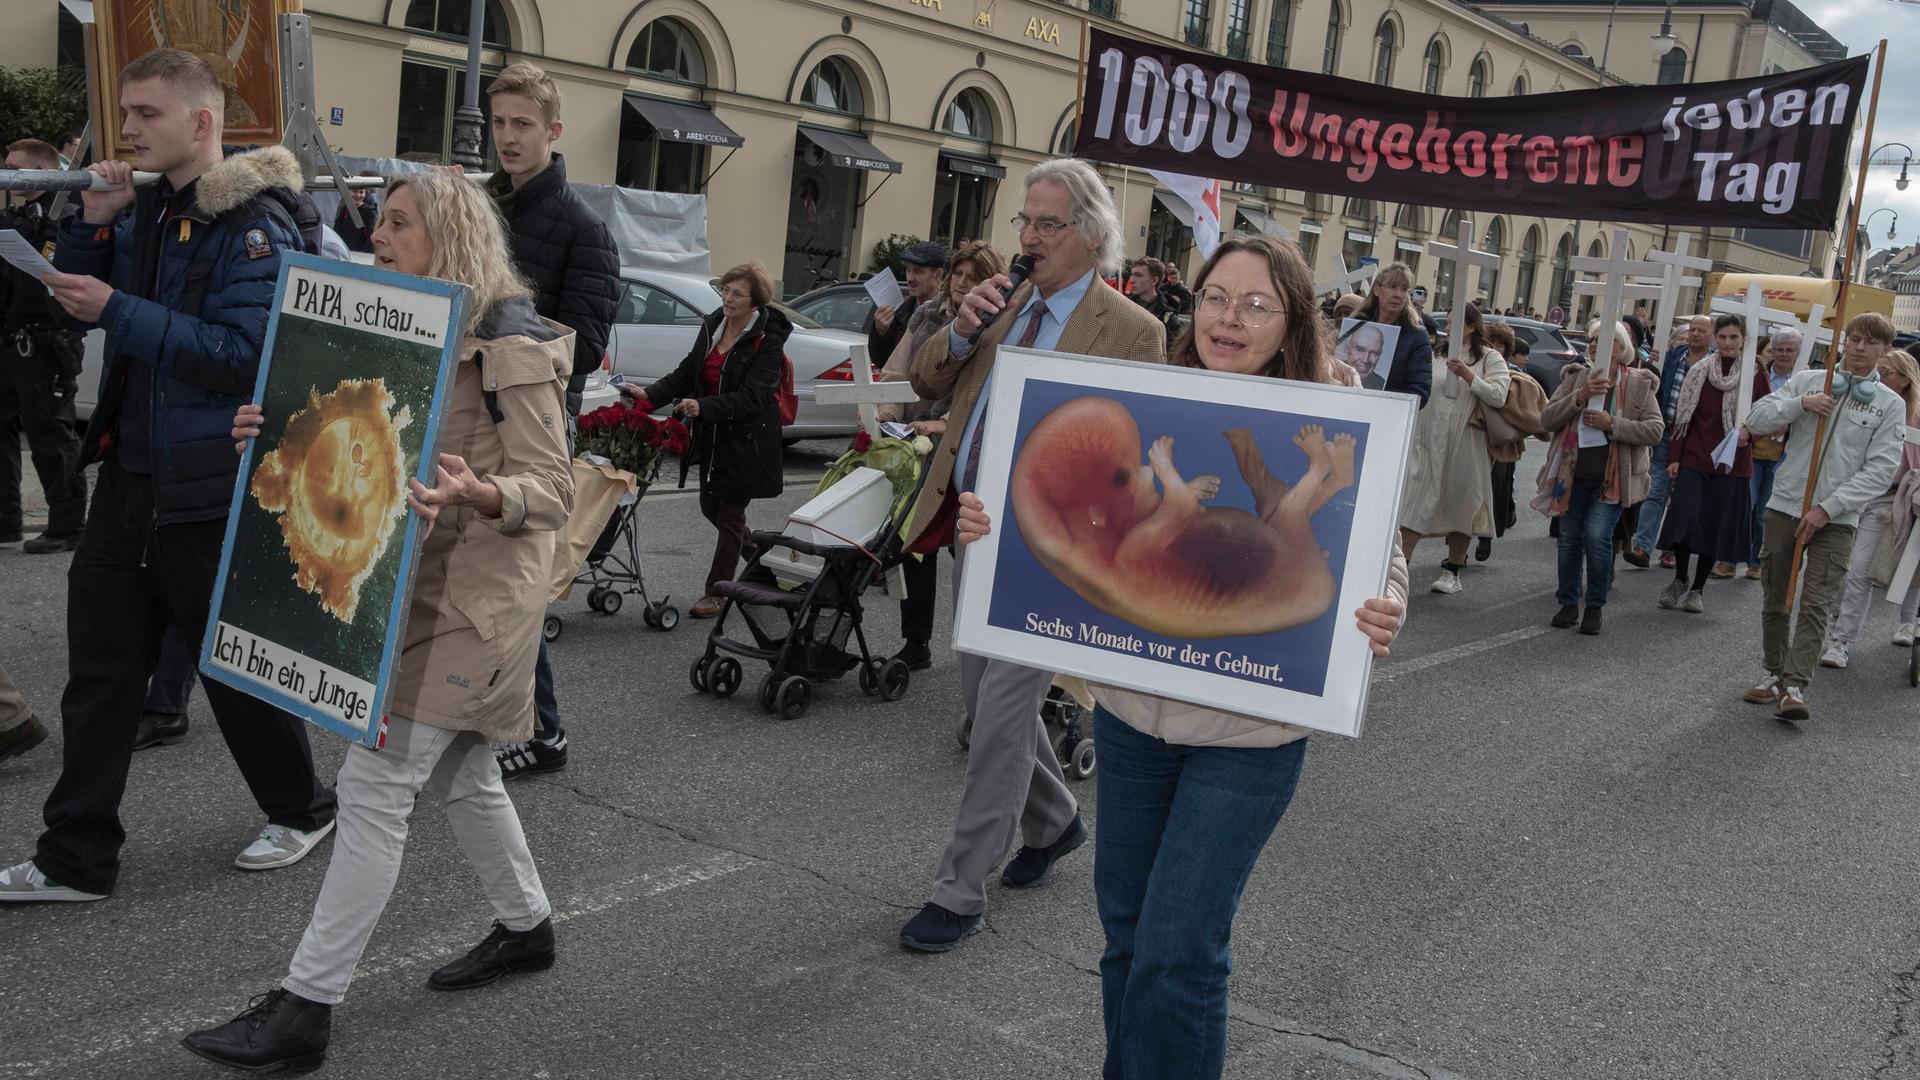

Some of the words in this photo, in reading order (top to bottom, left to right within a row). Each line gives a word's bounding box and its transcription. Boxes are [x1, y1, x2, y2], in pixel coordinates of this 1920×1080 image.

[1024, 16, 1061, 46] AXA
[1094, 47, 1252, 159] 1000
[1269, 88, 1644, 188] Ungeborene
[1662, 82, 1851, 142] jeden
[1693, 151, 1800, 215] Tag
[294, 278, 346, 326] PAPA,
[213, 624, 243, 667] Ich
[247, 638, 273, 680] bin
[278, 660, 305, 694] ein
[308, 669, 368, 721] Junge
[1025, 612, 1073, 640] Sechs
[1077, 623, 1143, 651] Monate
[1148, 641, 1176, 660] vor
[1179, 642, 1211, 667] der
[1214, 651, 1283, 682] Geburt.
